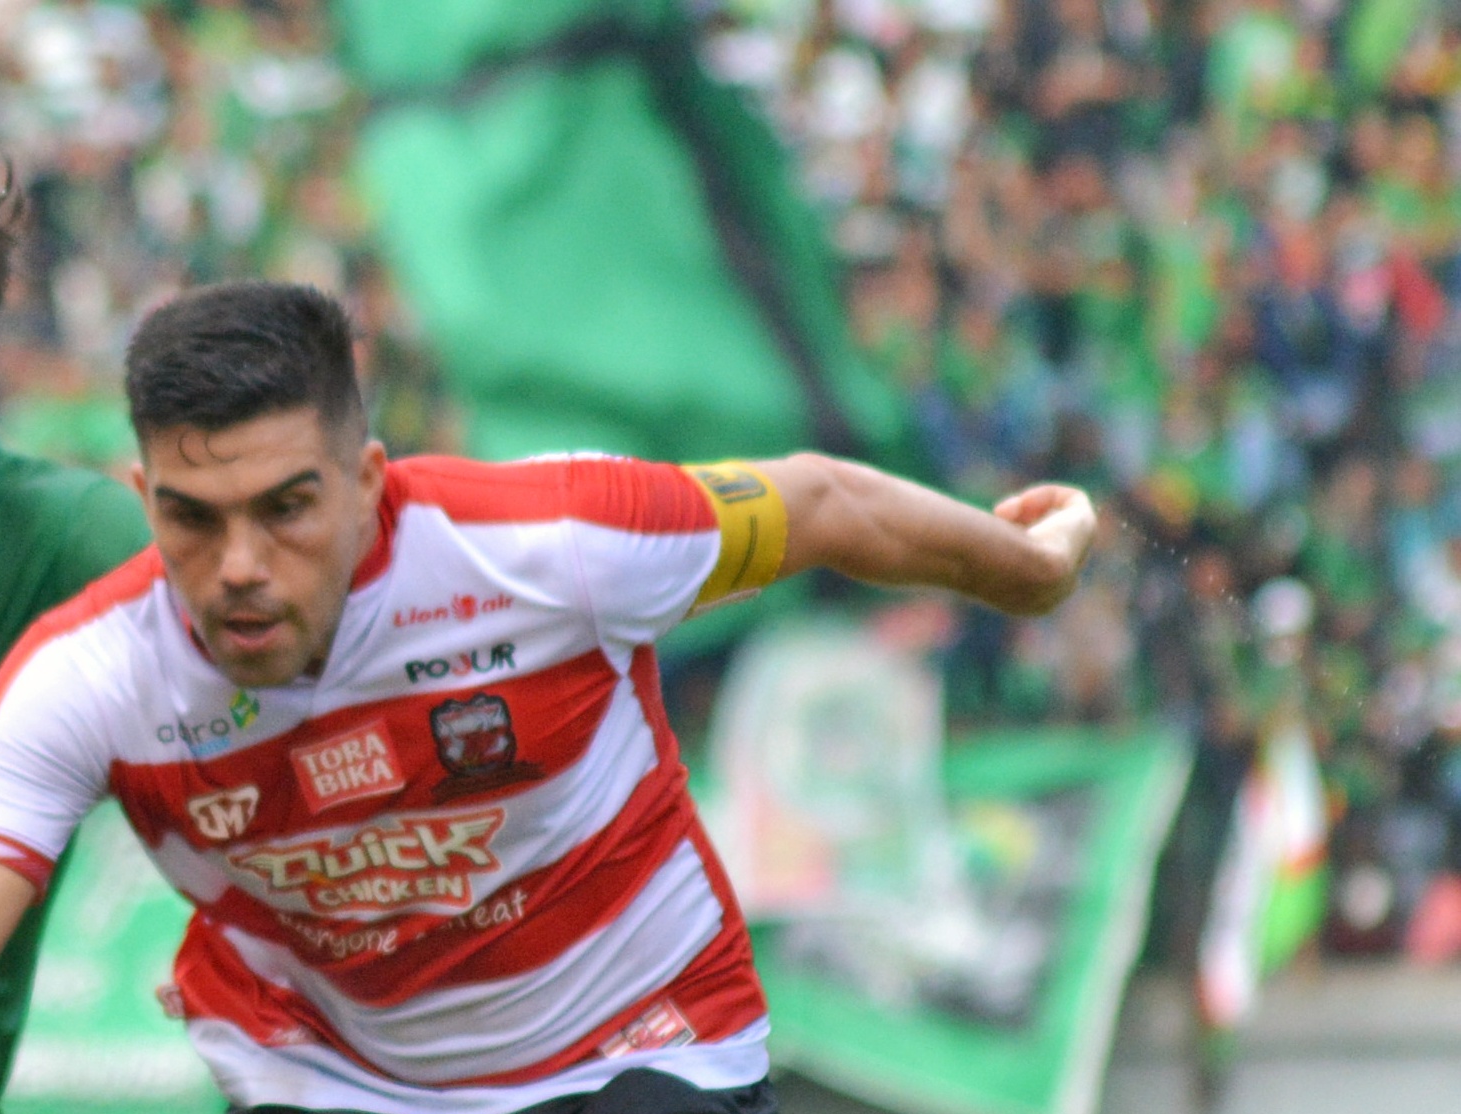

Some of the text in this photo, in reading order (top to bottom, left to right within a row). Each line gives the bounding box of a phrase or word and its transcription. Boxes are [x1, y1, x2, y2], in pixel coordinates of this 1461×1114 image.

[299, 730, 388, 777] TORA
[312, 757, 395, 798] BIKA
[315, 874, 465, 907] CHICKEN
